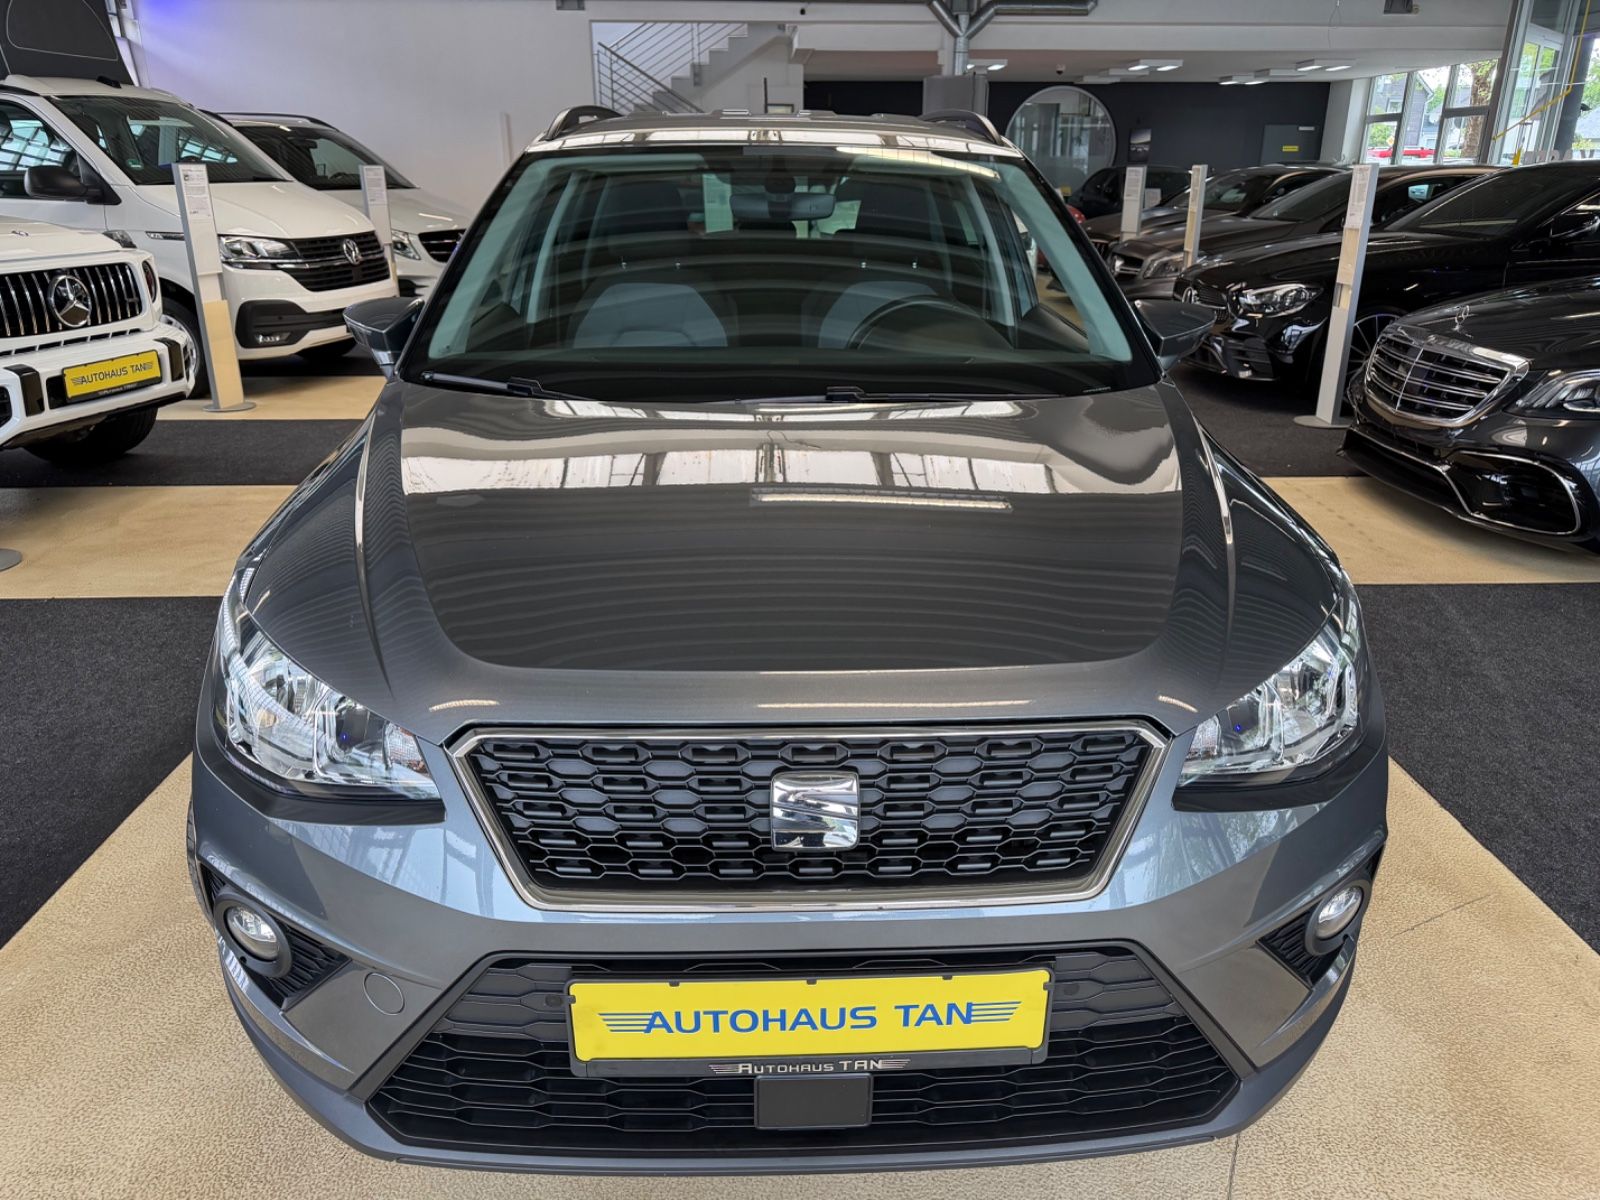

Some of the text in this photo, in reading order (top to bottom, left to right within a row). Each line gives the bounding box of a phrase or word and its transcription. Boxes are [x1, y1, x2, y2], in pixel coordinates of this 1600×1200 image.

[80, 363, 147, 384] AUTOHAUS TAN
[643, 1002, 973, 1034] AUTOHAUS TAN
[839, 1060, 882, 1071] TAN
